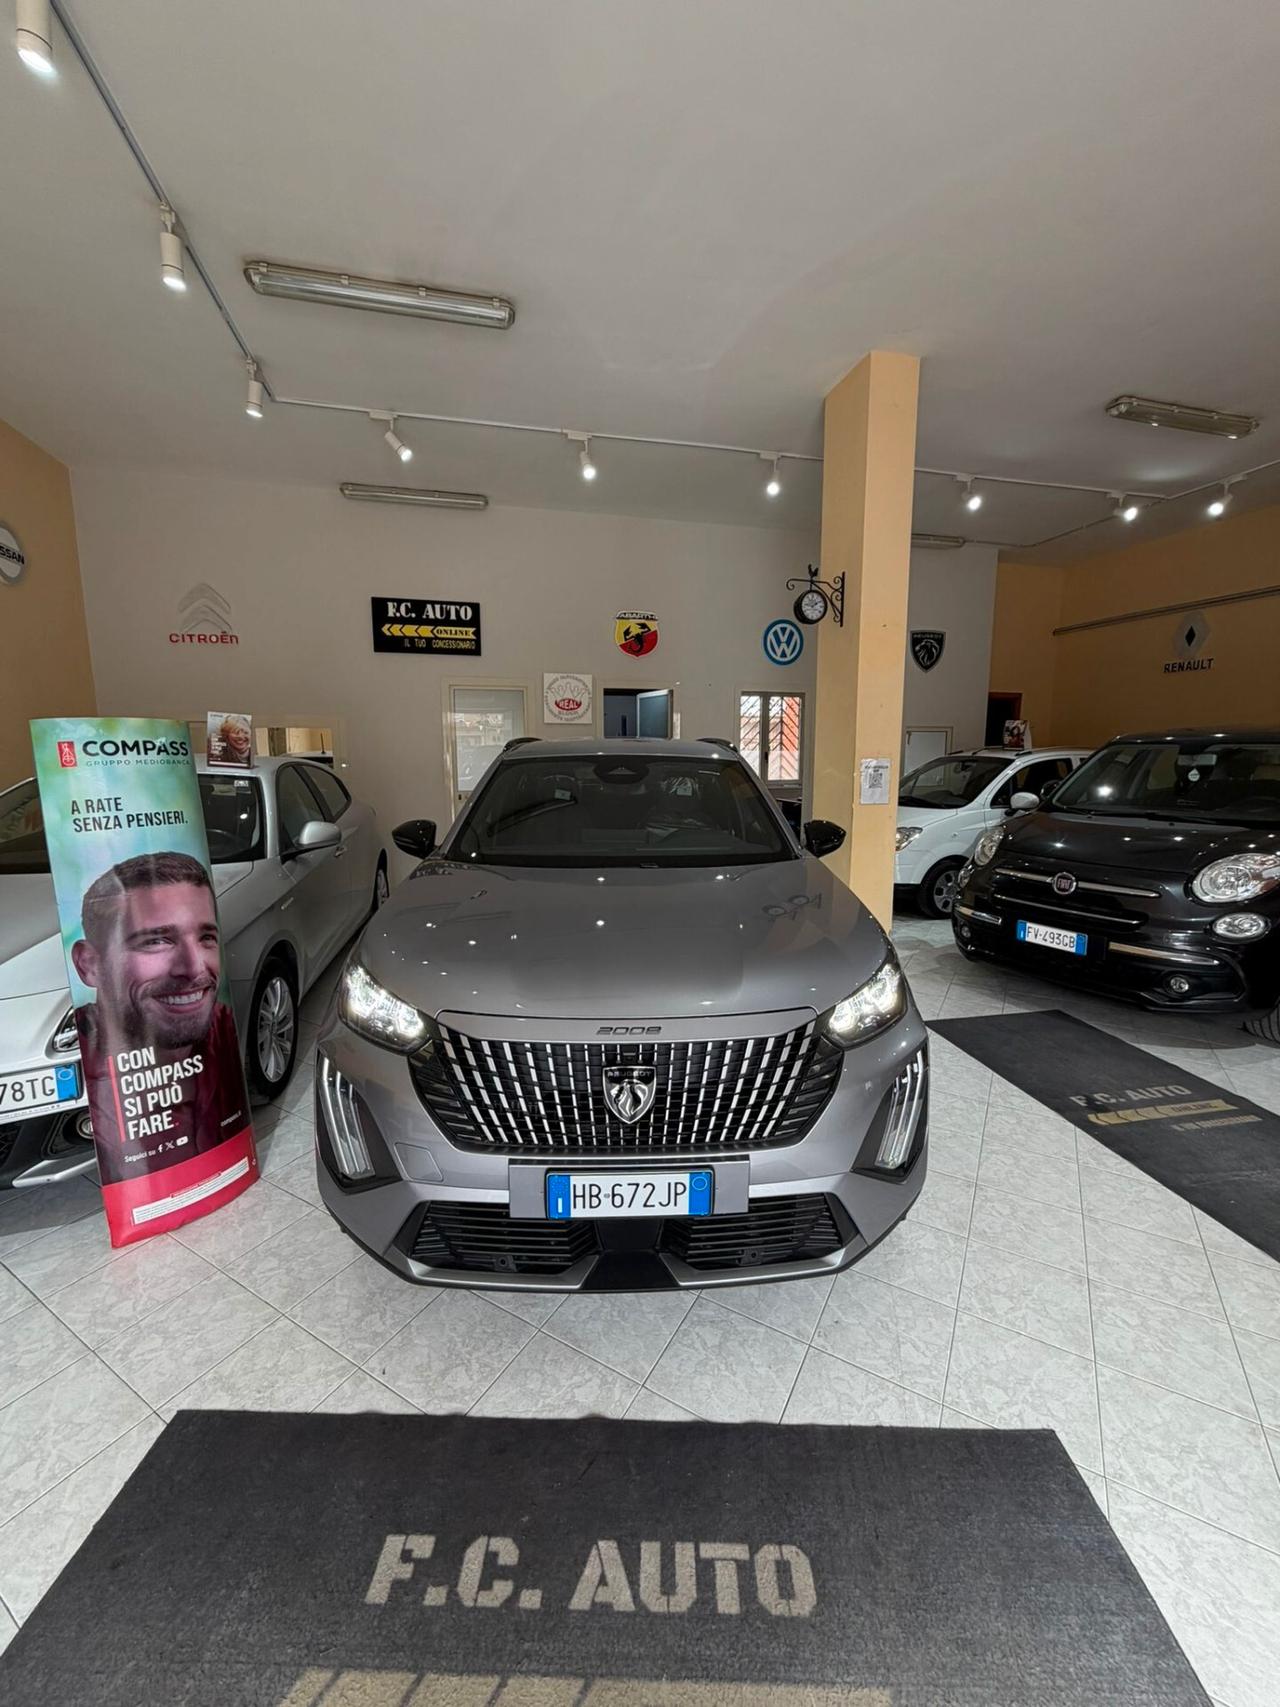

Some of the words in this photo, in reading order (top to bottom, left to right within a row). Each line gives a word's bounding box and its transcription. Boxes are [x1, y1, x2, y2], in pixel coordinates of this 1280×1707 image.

[387, 602, 416, 618] F.C.
[422, 604, 473, 620] AUTO
[436, 628, 471, 637] ONLINE
[415, 639, 427, 648] TUO
[432, 640, 476, 650] CONCESSIONARIO
[1163, 658, 1214, 674] RENAULT
[559, 699, 579, 709] REAL
[82, 739, 188, 757] COMPASS
[86, 759, 132, 767] GRUPPO
[71, 801, 81, 815] A
[86, 797, 123, 814] RATE
[72, 816, 122, 833] SENZA
[126, 810, 188, 828] PENSIERI.
[596, 1026, 662, 1035] 2008
[117, 1046, 156, 1073] CON
[120, 1055, 204, 1096] COMPASS
[124, 1096, 143, 1118] SI
[147, 1081, 183, 1112] PUÒ
[1126, 1084, 1192, 1101] AUTO
[124, 1150, 148, 1163] Seguici
[364, 1534, 543, 1610] F.C.
[567, 1540, 818, 1618] AUTO
